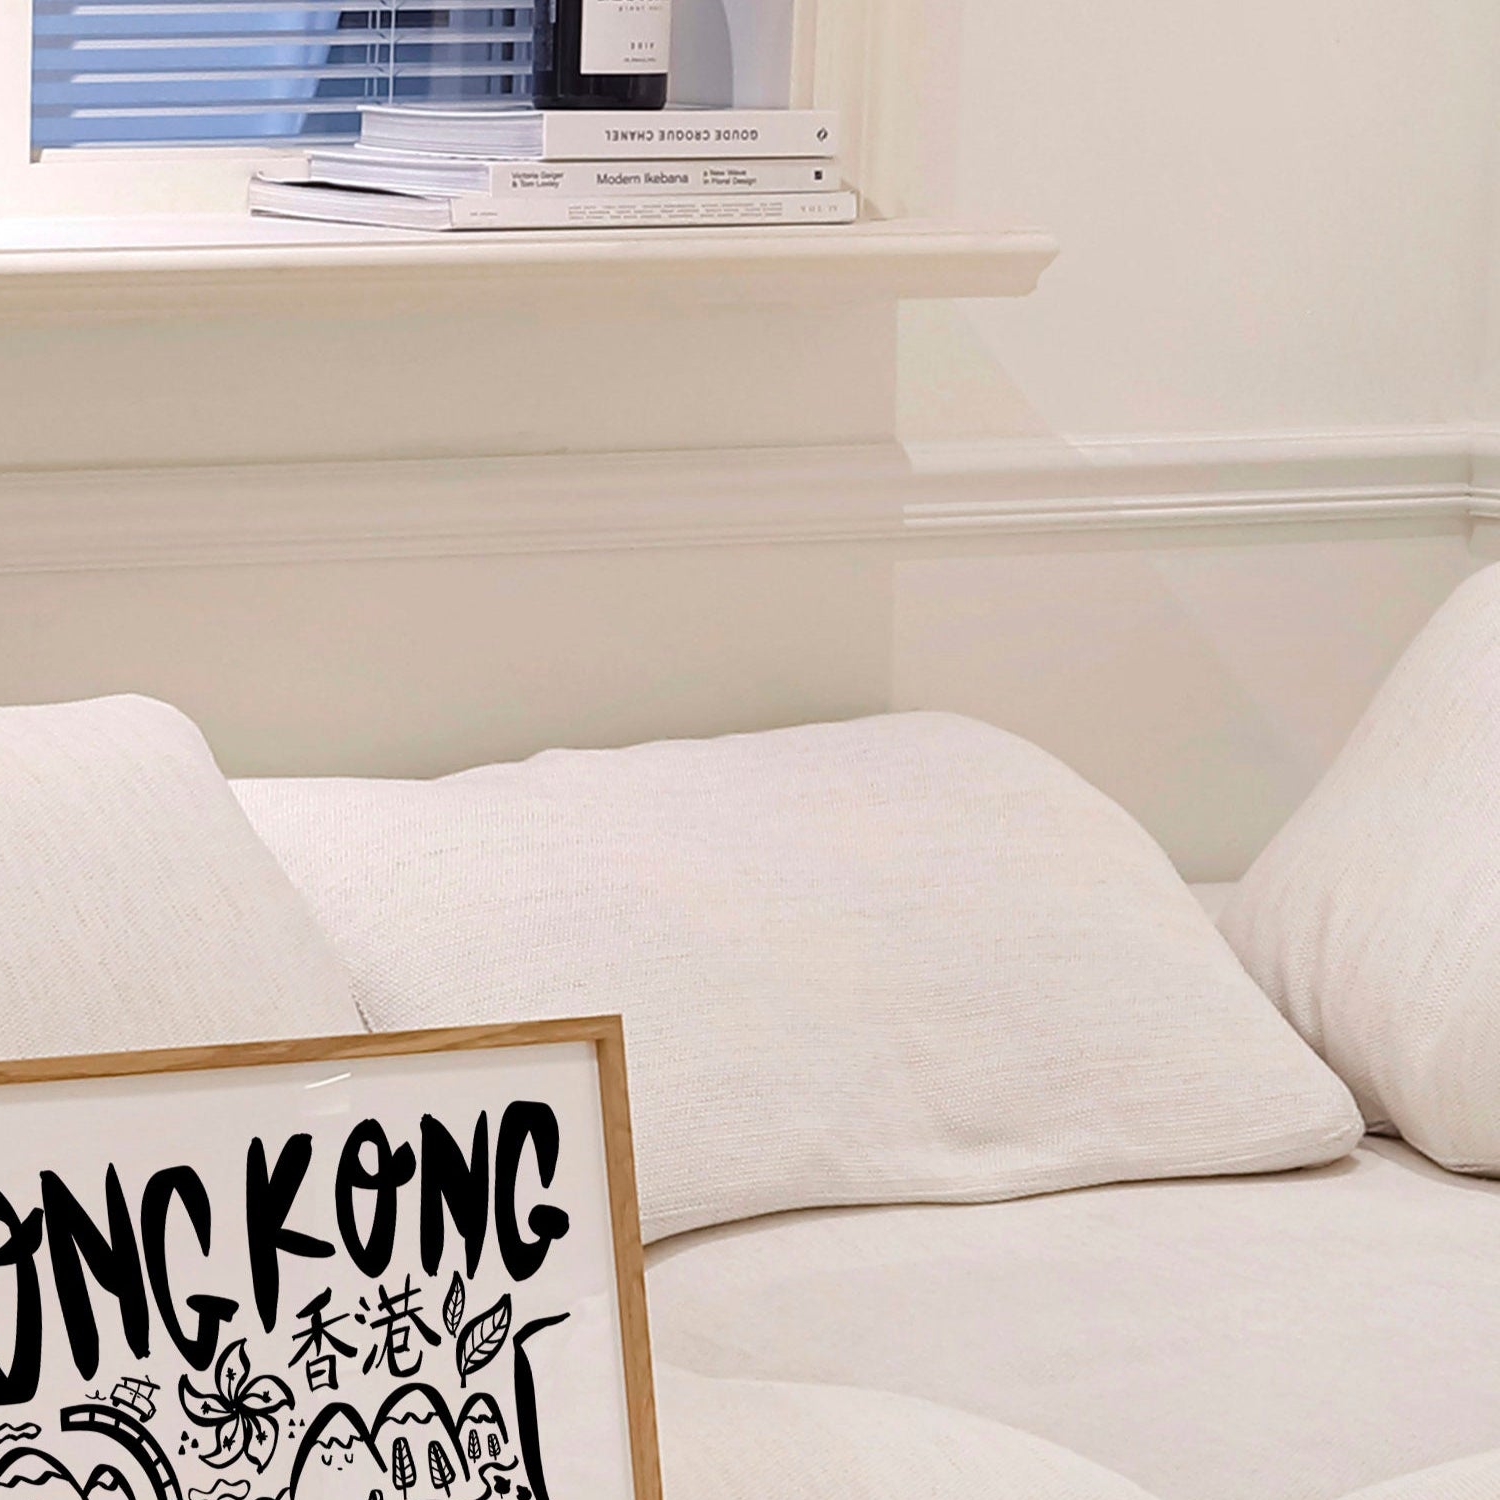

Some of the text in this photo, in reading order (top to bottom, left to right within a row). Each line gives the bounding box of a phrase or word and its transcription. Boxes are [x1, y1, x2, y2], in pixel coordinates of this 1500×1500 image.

[605, 130, 759, 142] GOUDE CROQUE CHANEL
[596, 172, 689, 186] Modern Ikebana
[246, 1101, 570, 1334] KONG
[288, 1273, 442, 1392] 香港
